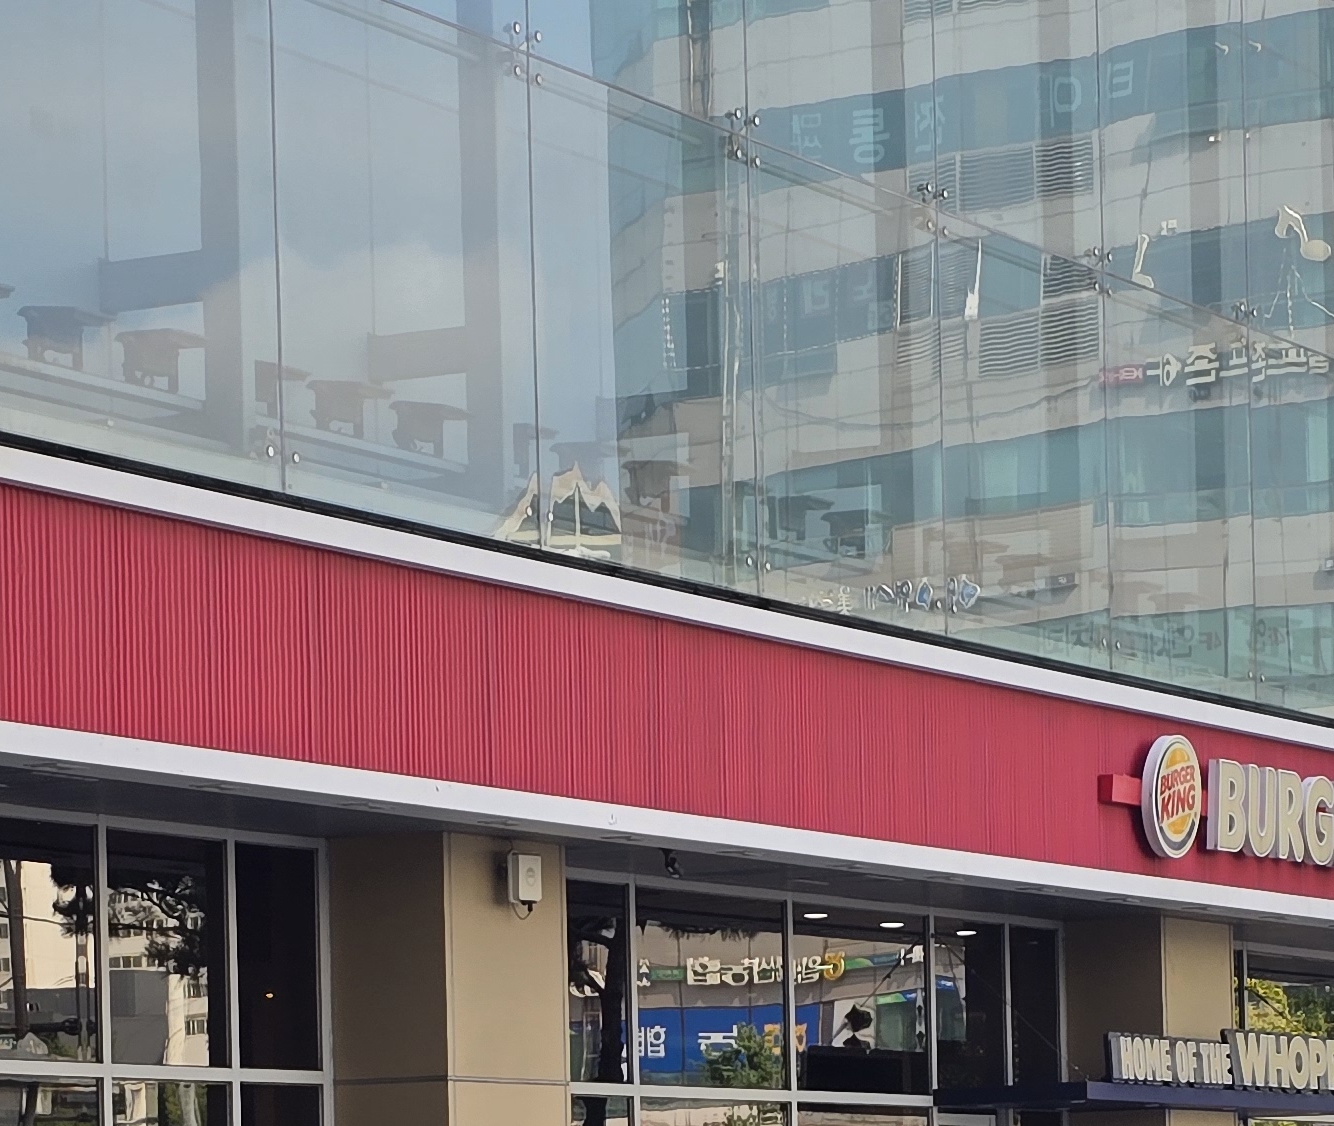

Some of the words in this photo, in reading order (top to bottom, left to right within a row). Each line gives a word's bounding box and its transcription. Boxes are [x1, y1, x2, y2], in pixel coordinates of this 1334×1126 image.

[1160, 764, 1196, 797] BURGER
[1160, 784, 1196, 825] KING
[1118, 1035, 1173, 1083] HOME
[1174, 1040, 1199, 1083] OF
[1199, 1042, 1234, 1085] THE
